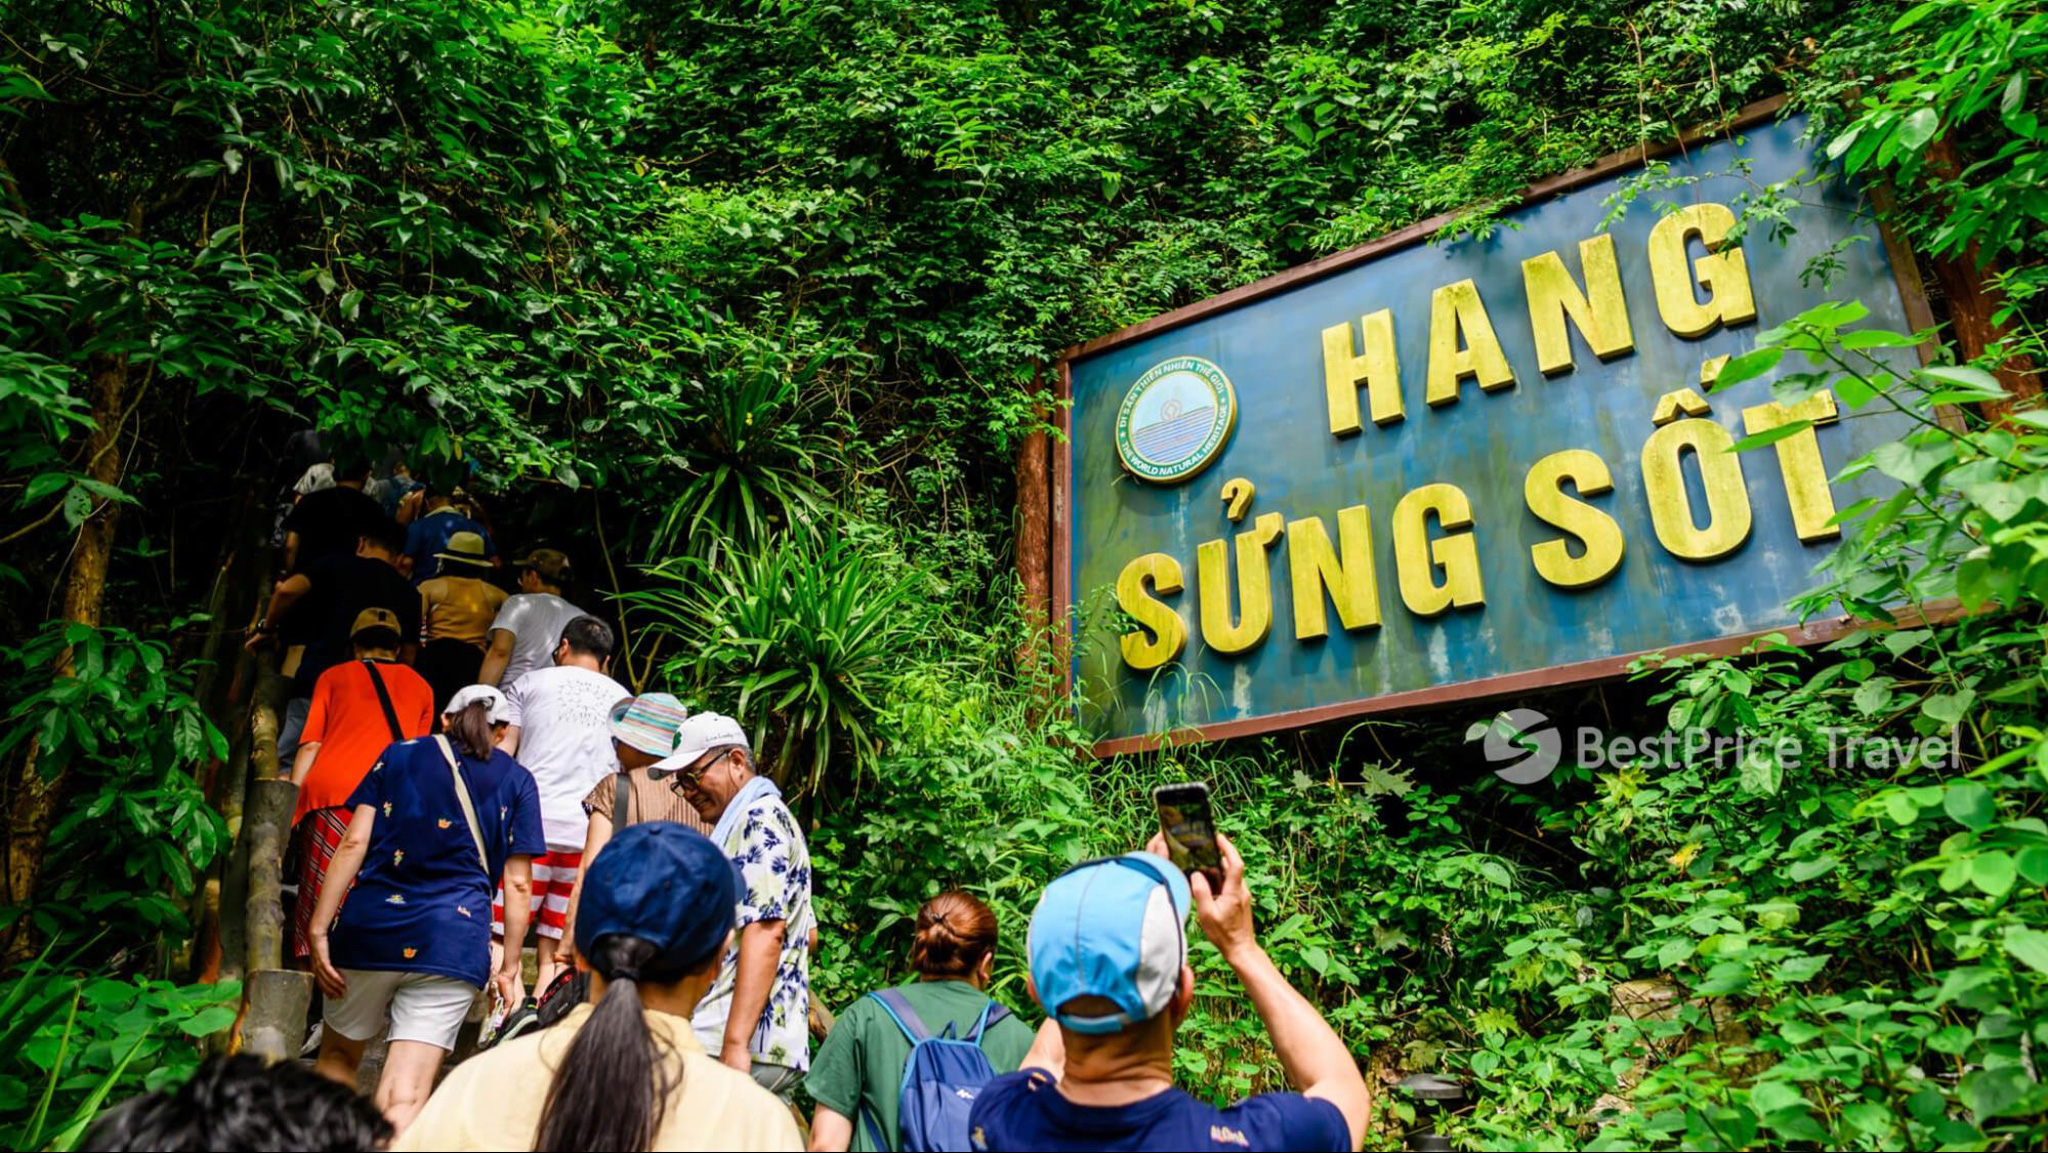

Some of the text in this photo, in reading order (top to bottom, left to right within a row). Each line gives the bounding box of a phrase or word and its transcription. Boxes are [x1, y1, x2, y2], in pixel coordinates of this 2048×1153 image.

[1322, 202, 1756, 433] HANG
[1117, 354, 1841, 670] SỬNG SỐT
[1121, 440, 1132, 459] THE
[1130, 455, 1159, 475] WORLD
[1159, 451, 1204, 476] NATURAL
[1203, 402, 1228, 455] HERITAGE
